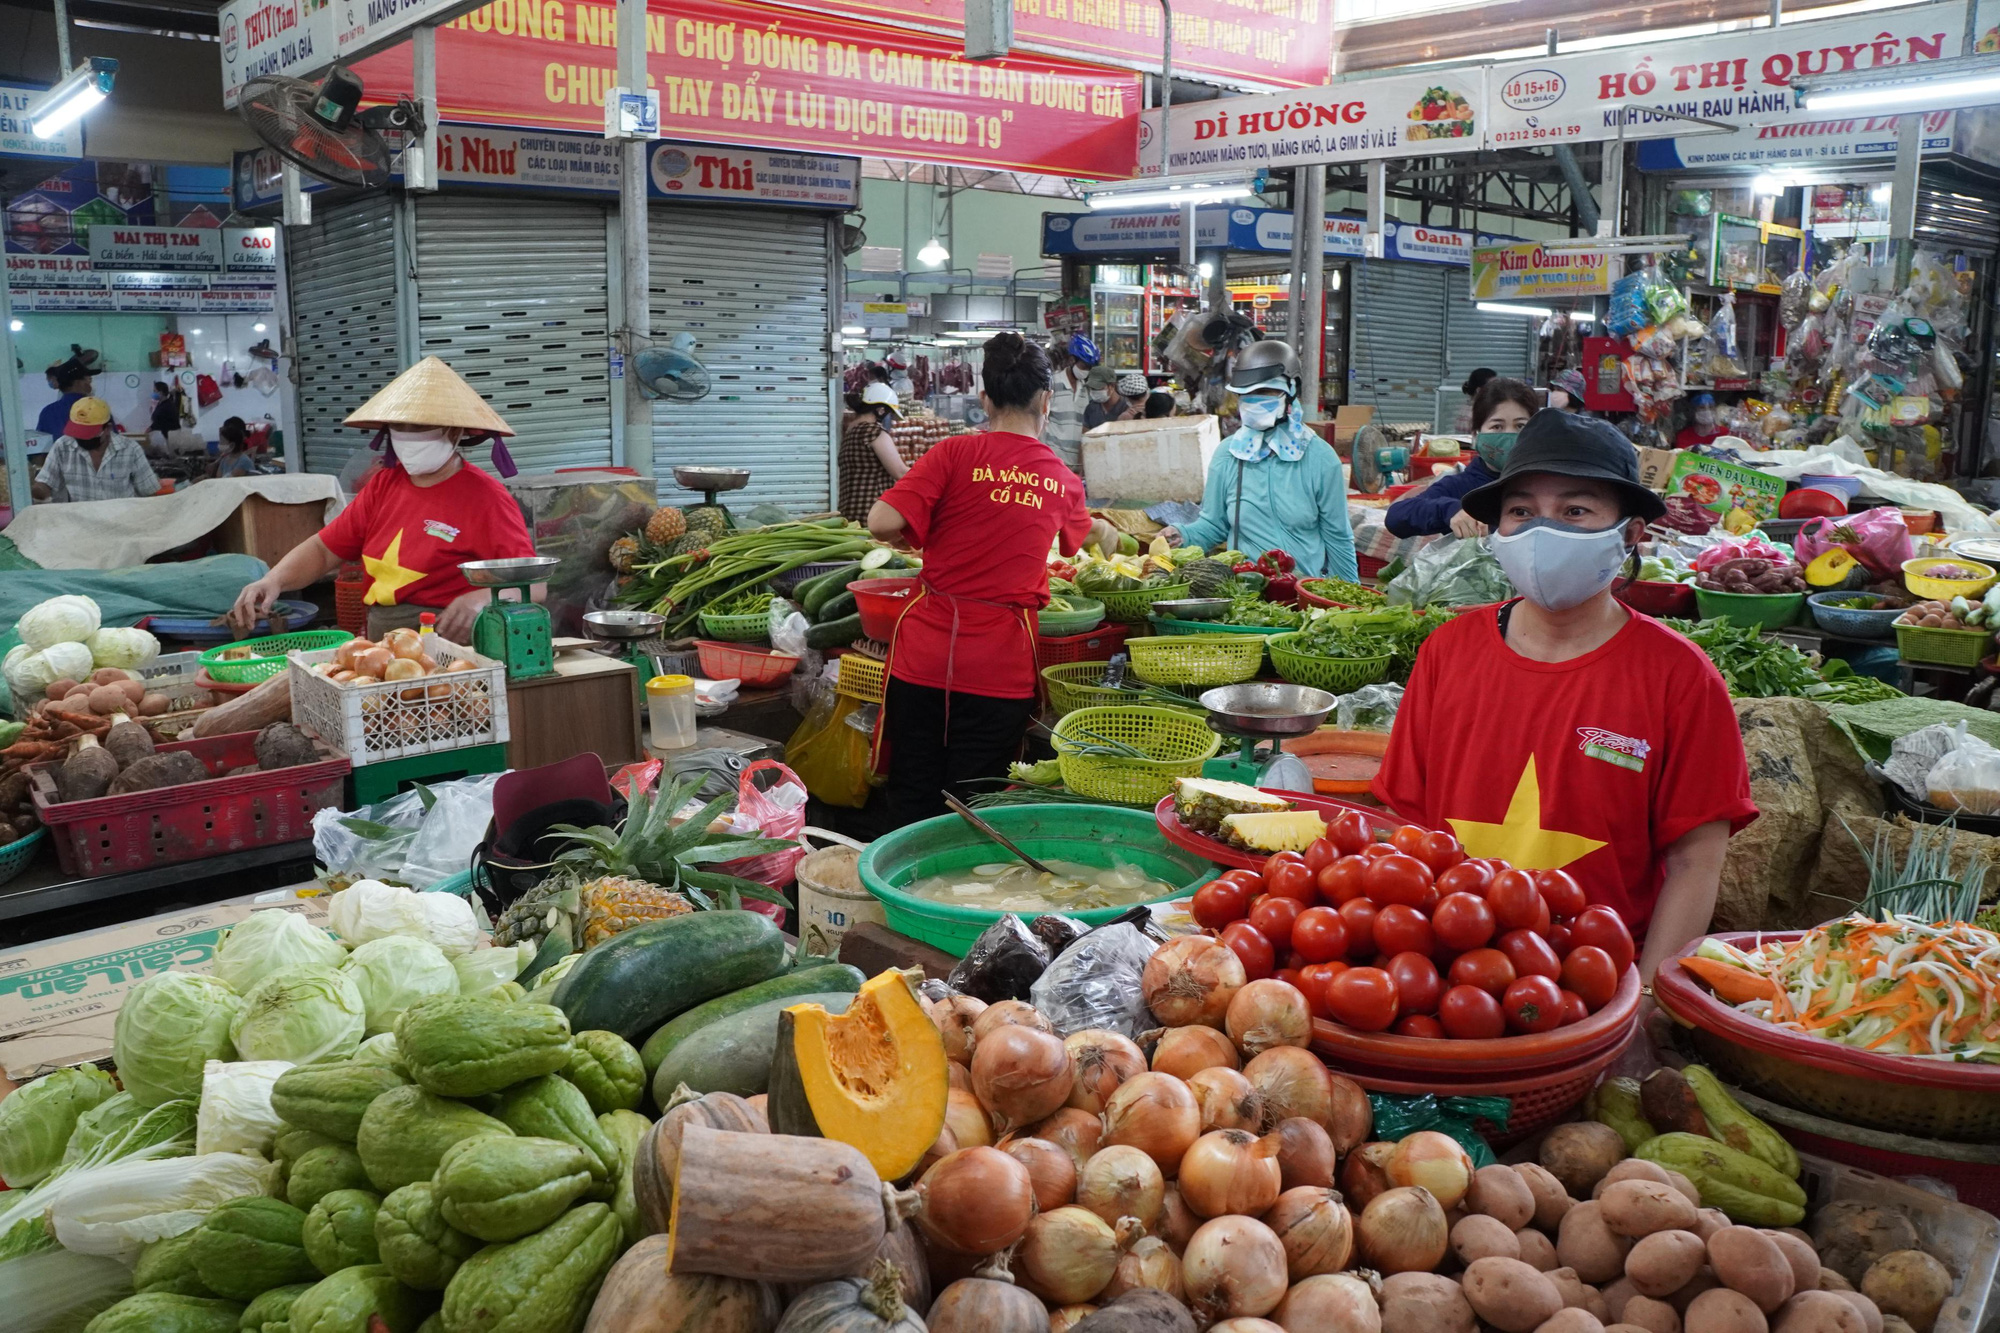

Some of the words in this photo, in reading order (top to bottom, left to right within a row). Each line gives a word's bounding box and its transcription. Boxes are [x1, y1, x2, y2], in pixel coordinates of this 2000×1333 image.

[298, 28, 314, 60] GIÁ
[576, 4, 665, 54] NHN
[676, 18, 735, 70] CHỢ
[826, 41, 861, 80] ĐA
[868, 48, 924, 89] CAM
[930, 51, 973, 95] KẾT
[979, 61, 1024, 103] BÁN
[1030, 70, 1086, 113] ĐÚNG
[1091, 82, 1125, 118] GIÁ
[1597, 56, 1657, 100] HỒ
[1670, 58, 1749, 92] THỊ
[1507, 81, 1521, 97] LÔ
[1525, 79, 1559, 95] 15+16
[0, 93, 11, 111] À
[664, 75, 713, 117] TAY
[721, 71, 777, 124] ĐẨY
[785, 85, 826, 129] LÙI
[834, 96, 893, 141] DỊCH
[900, 105, 968, 145] COVID
[1533, 94, 1555, 103] GIÁC
[1703, 97, 1733, 118] RAU
[1194, 111, 1229, 140] DÌ
[1237, 101, 1367, 136] HƯỜNG
[1496, 130, 1528, 142] 01212
[1532, 128, 1546, 139] 50
[1549, 127, 1562, 137] 41
[1567, 125, 1581, 136] 59
[460, 136, 517, 176] Như
[520, 138, 555, 152] CHUYÊN
[558, 140, 582, 155] CUNG
[584, 139, 601, 156] CẤP
[1169, 153, 1187, 168] KINH
[1190, 149, 1218, 164] DOANH
[1220, 144, 1246, 162] MĂNG
[1272, 138, 1298, 156] MĂNG
[1326, 138, 1337, 152] LA
[1339, 135, 1358, 152] GIM
[1372, 129, 1385, 148] VÀ
[1687, 155, 1704, 163] KINH
[1706, 153, 1730, 163] DOANH
[1732, 152, 1747, 161] CÁC
[1766, 148, 1787, 159] HÀNG
[1789, 148, 1802, 157] GIA
[528, 155, 545, 169] CÁC
[548, 158, 567, 174] LOẠI
[694, 154, 754, 191] Thi
[1110, 216, 1159, 229] THANH
[1161, 214, 1181, 227] NG
[1337, 221, 1360, 234] NGA
[114, 232, 140, 244] MAI
[143, 233, 167, 248] THỊ
[170, 234, 200, 246] TAM
[241, 236, 271, 249] CAO
[1414, 229, 1463, 246] Oanh
[1500, 250, 1528, 271] Kim
[972, 464, 995, 482] ĐÀ
[997, 465, 1039, 487] NẴNG
[1749, 476, 1779, 493] XANH
[990, 484, 1013, 504] CỐ
[1014, 489, 1043, 510] LÊN
[73, 938, 188, 971] COOKING
[19, 966, 70, 984] OIL
